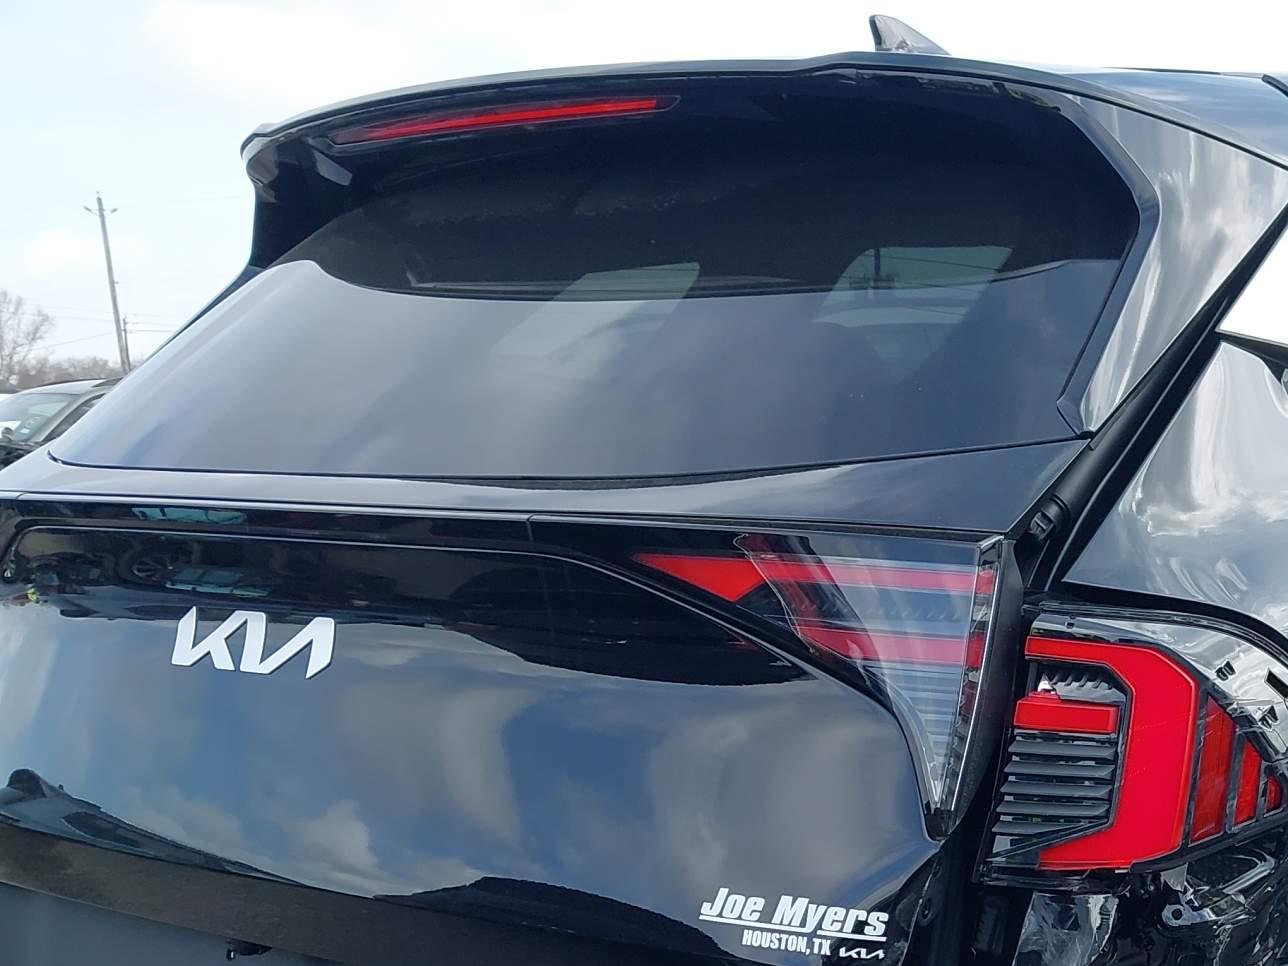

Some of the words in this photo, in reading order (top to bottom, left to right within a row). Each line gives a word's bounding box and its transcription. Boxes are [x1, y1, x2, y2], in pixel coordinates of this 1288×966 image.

[700, 887, 766, 921] Joe
[771, 894, 889, 936] Myers
[741, 929, 811, 956] HOUSTON,
[812, 937, 832, 956] TX
